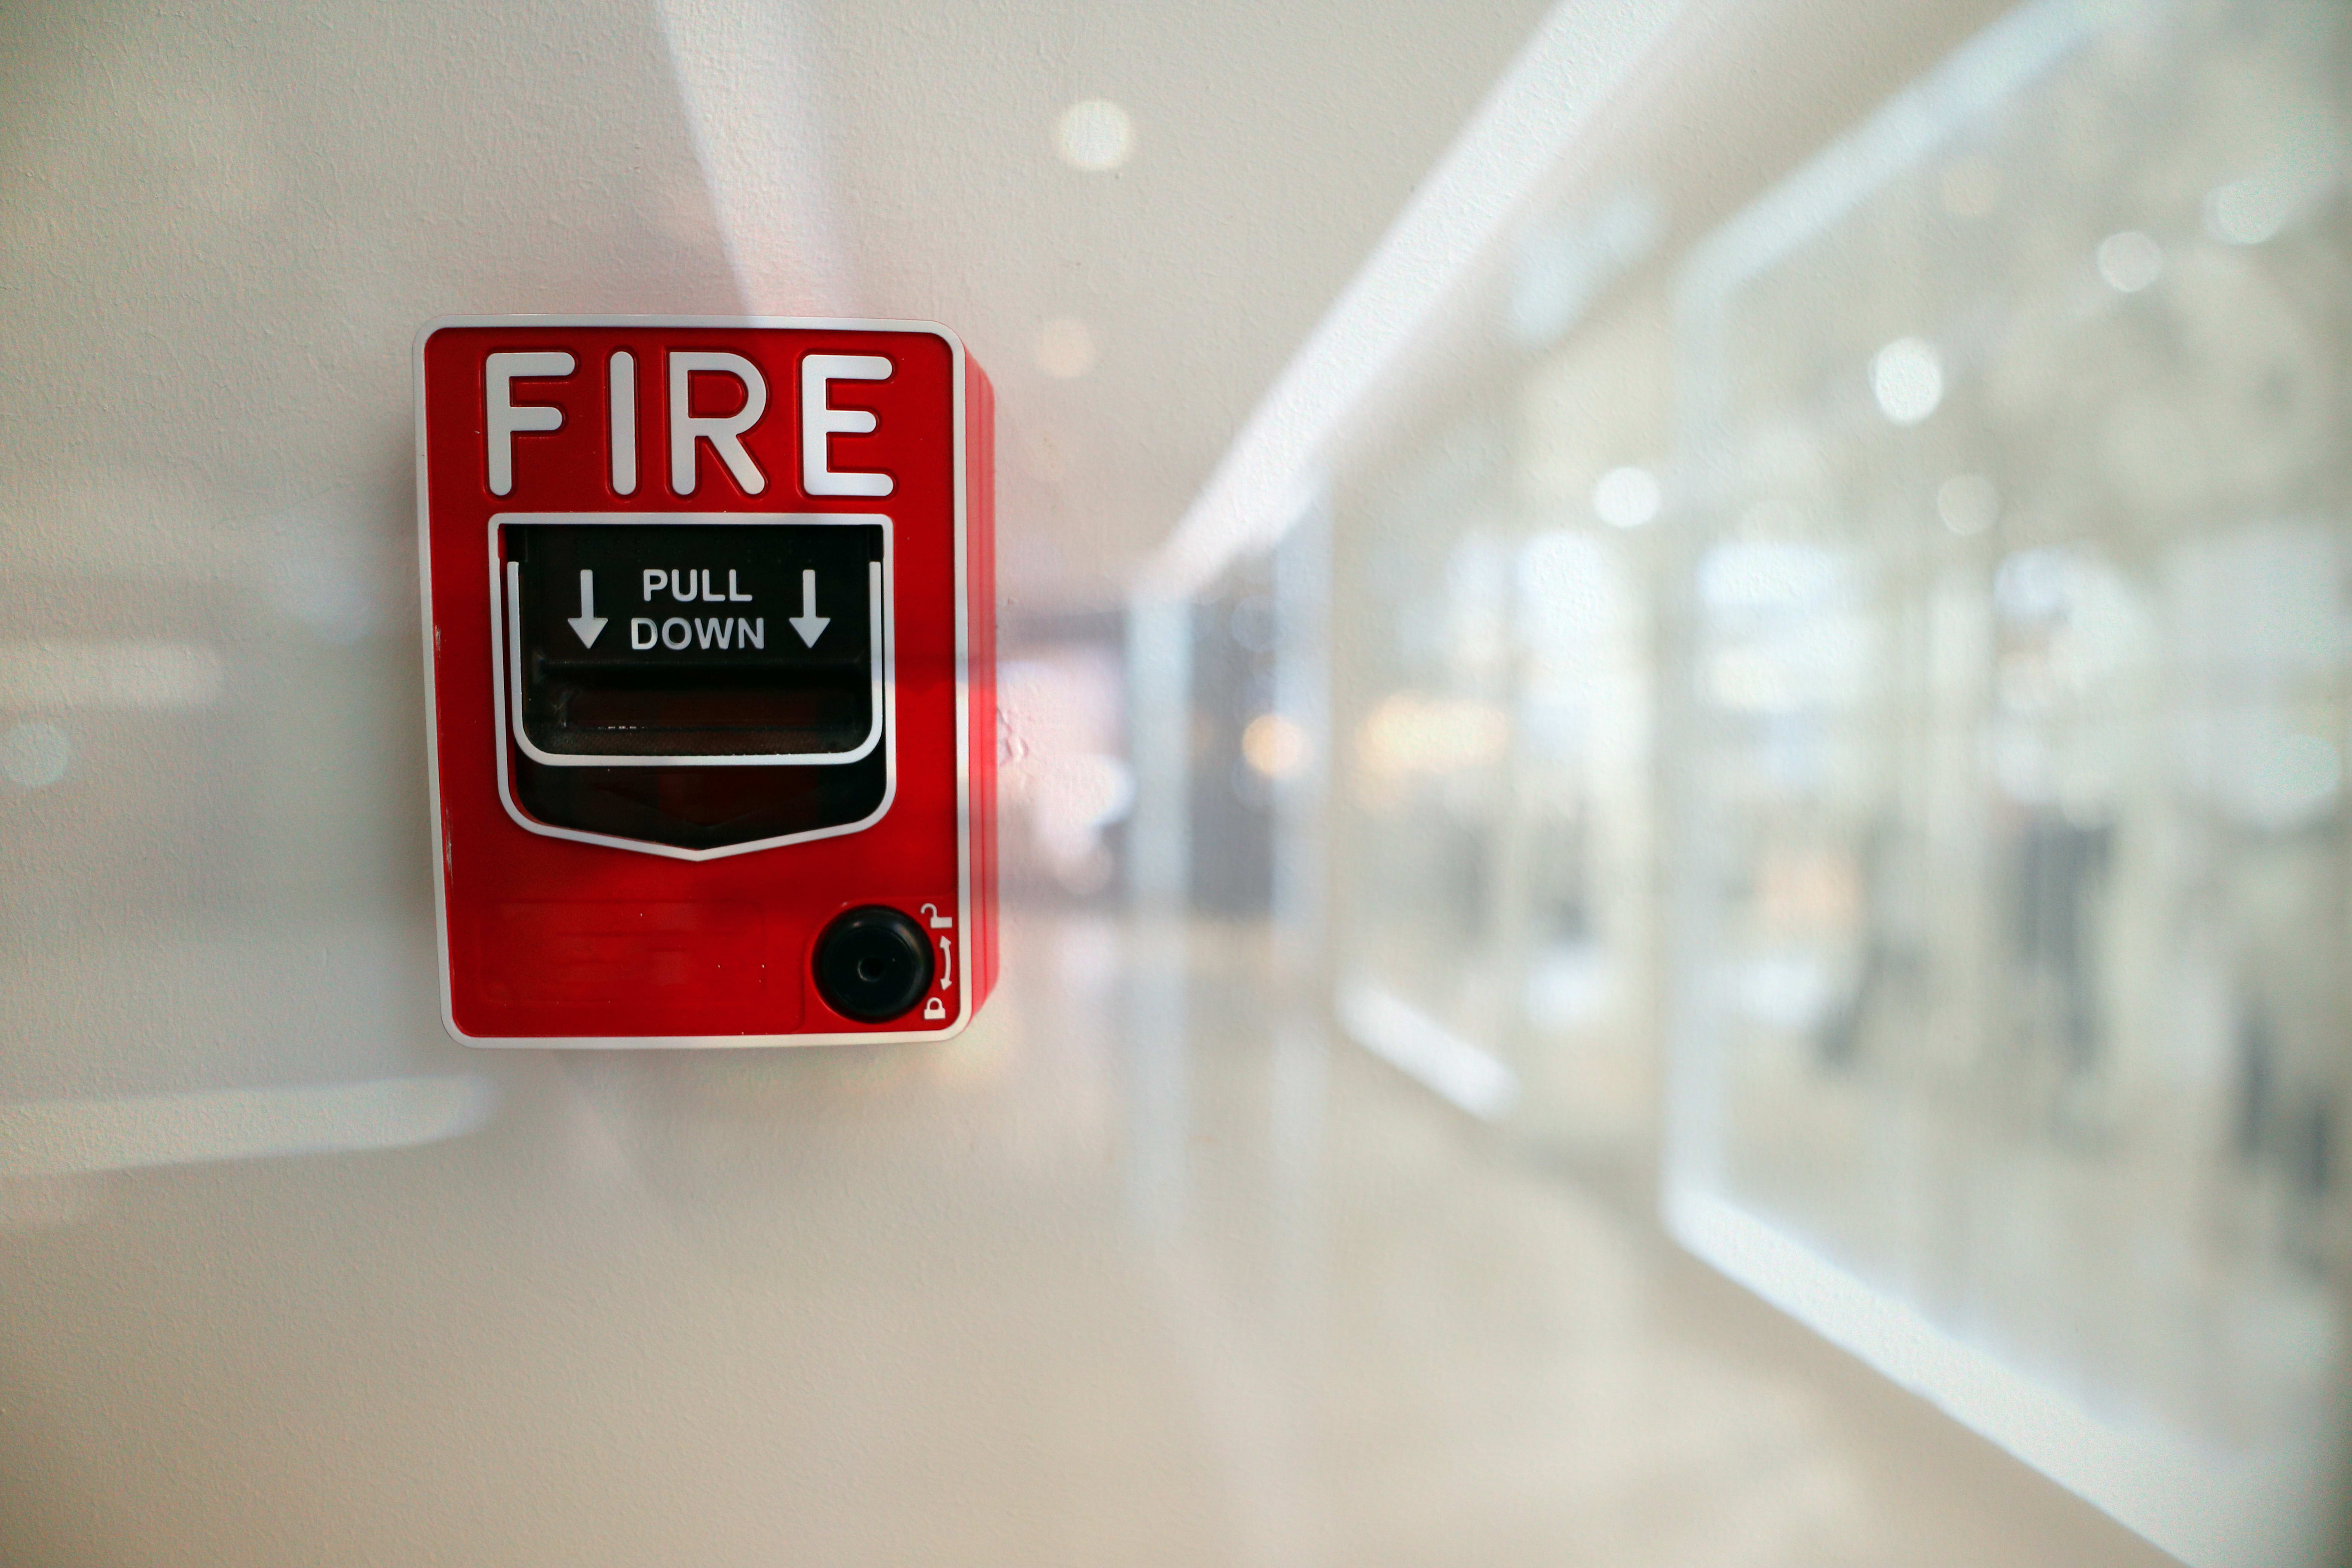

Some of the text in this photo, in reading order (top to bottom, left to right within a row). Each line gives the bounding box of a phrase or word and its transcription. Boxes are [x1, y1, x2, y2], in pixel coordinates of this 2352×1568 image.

[486, 352, 894, 496] FIRE
[643, 569, 753, 602] PULL
[631, 617, 764, 649] DOWN
